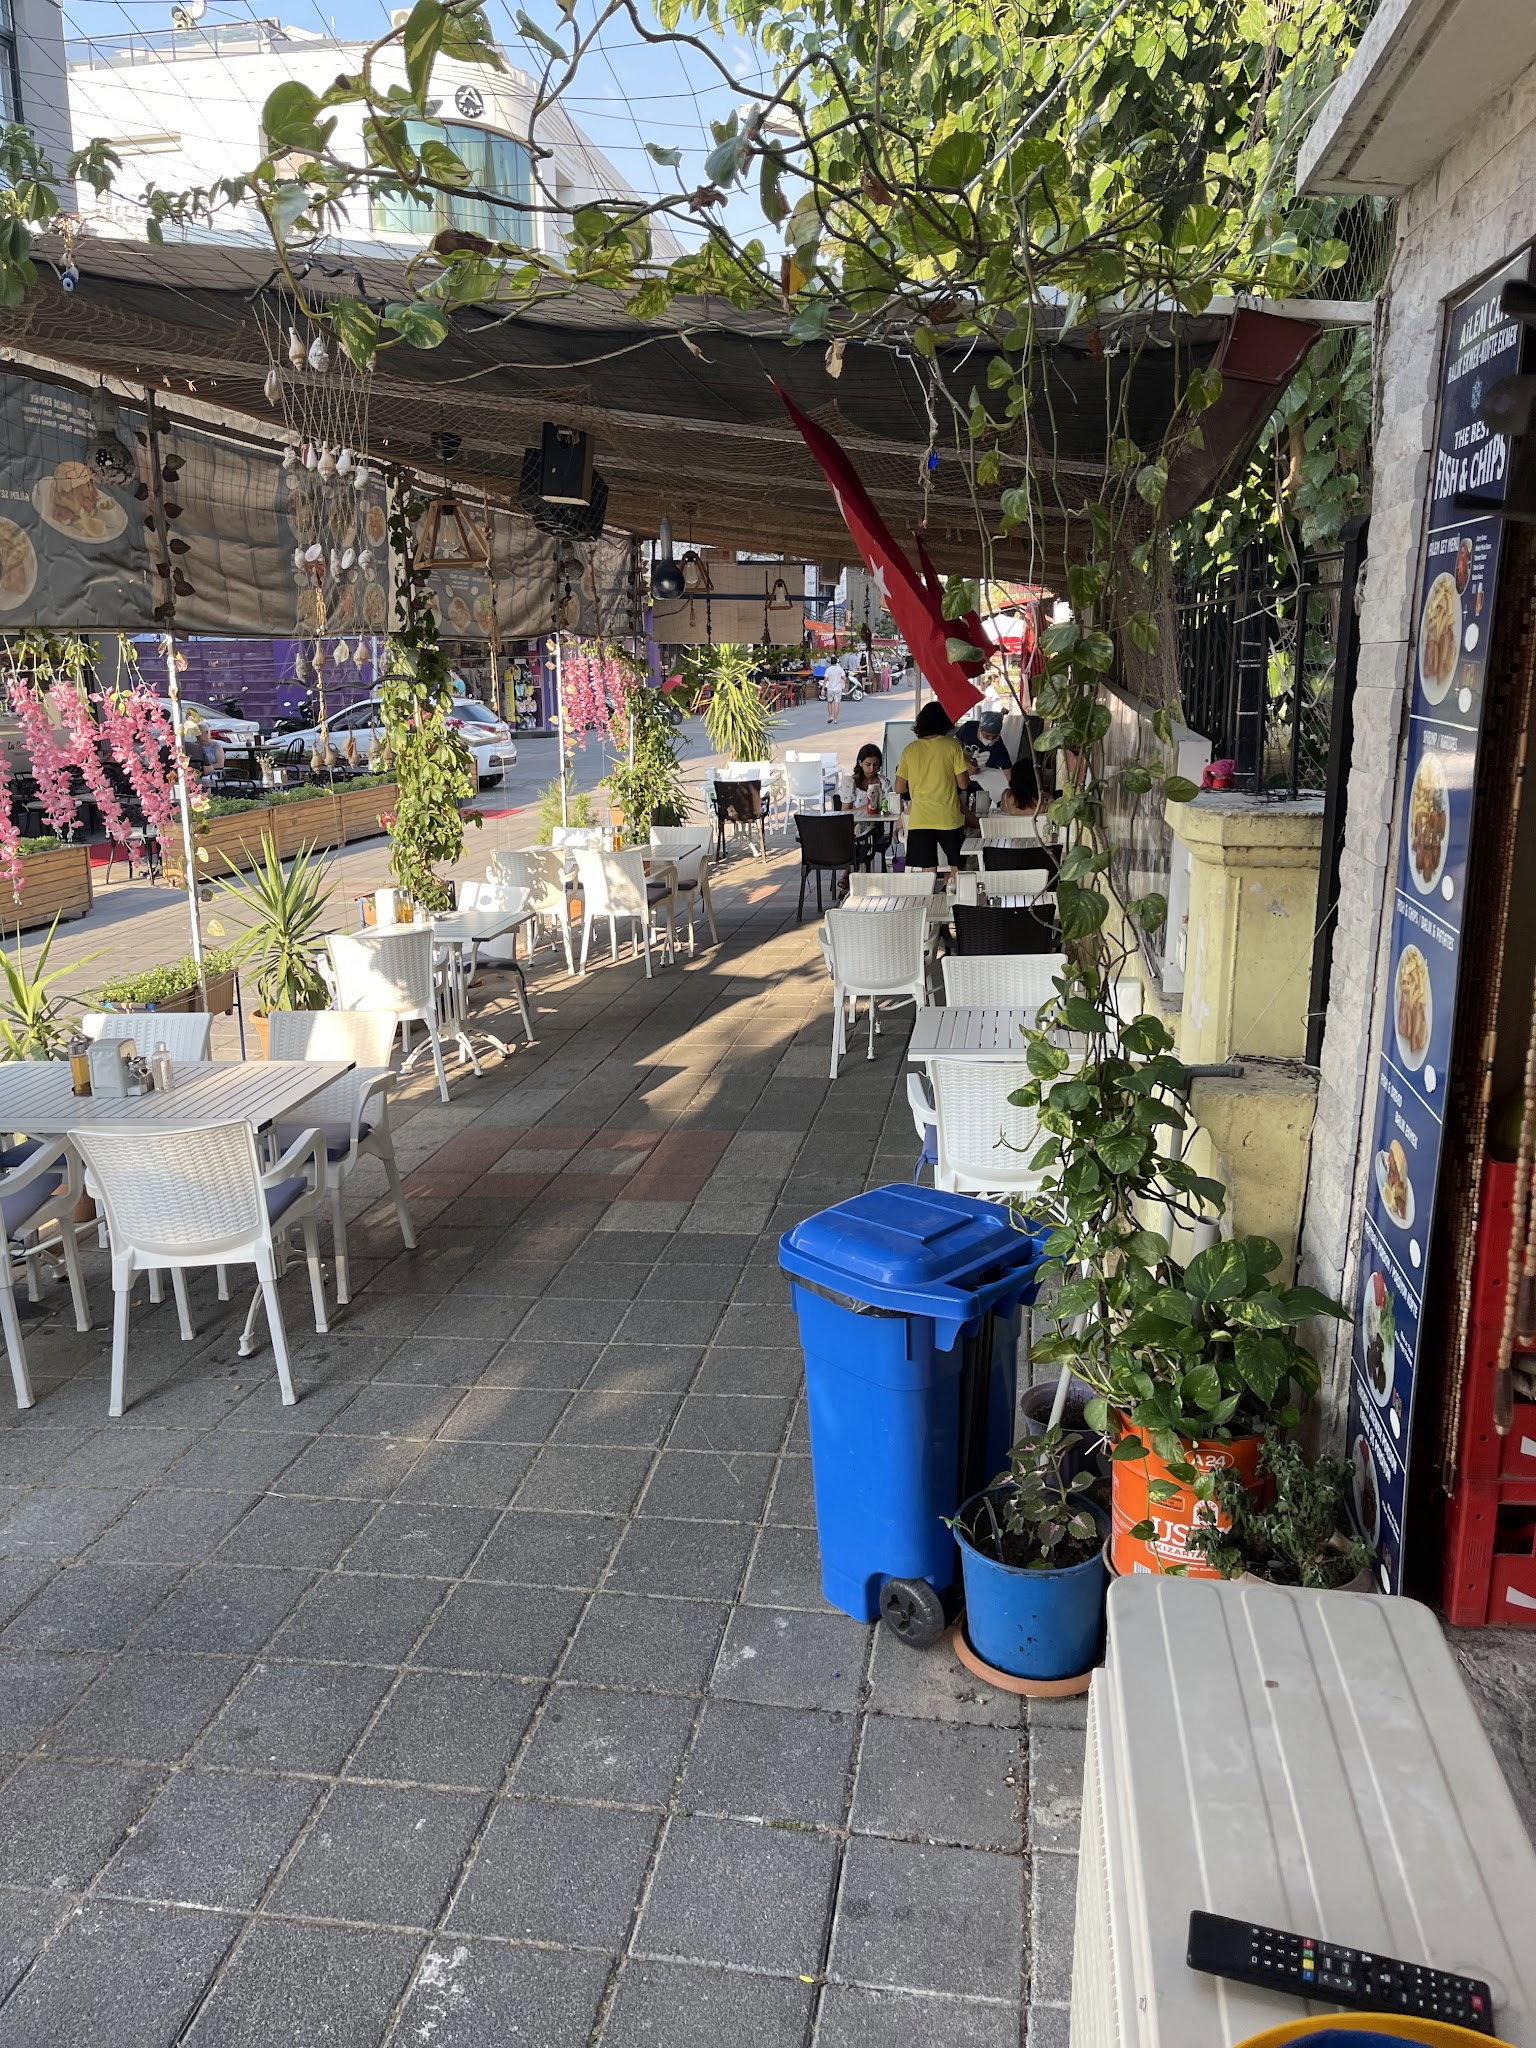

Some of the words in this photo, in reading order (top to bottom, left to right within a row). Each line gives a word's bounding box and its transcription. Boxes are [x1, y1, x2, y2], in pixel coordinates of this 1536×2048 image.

[1488, 294, 1510, 329] CA
[1455, 426, 1471, 450] THE
[1433, 448, 1460, 500] FISH
[1459, 457, 1469, 493] &
[1469, 433, 1506, 489] CHIPS
[1205, 1455, 1226, 1467] 24
